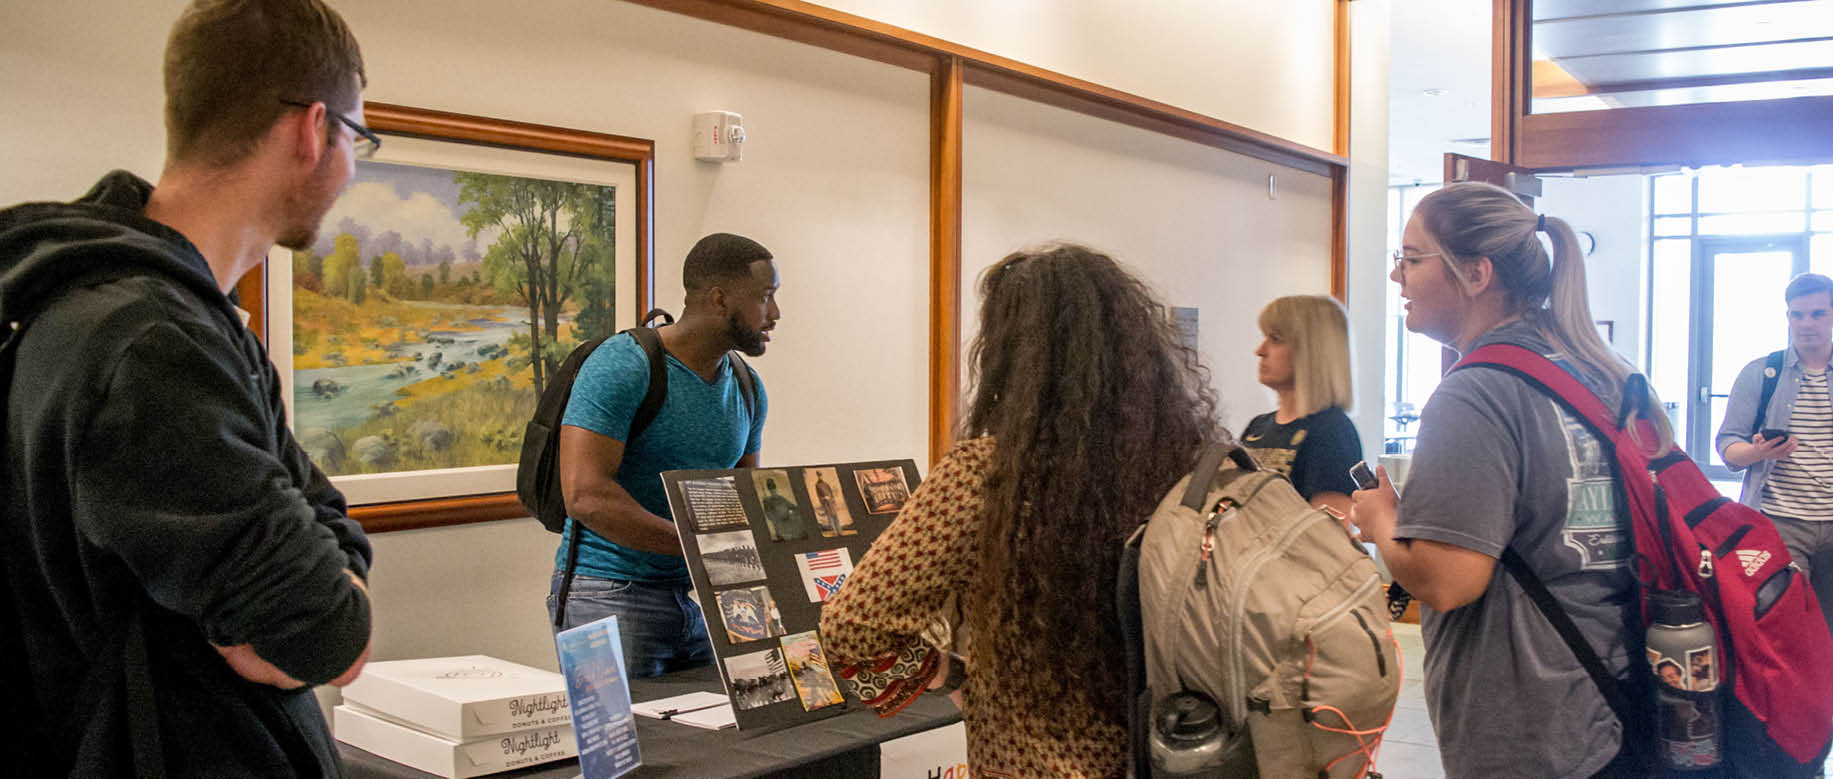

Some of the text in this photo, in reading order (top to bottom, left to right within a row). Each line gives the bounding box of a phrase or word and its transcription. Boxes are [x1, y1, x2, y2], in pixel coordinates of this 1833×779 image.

[1743, 549, 1772, 577] adidas
[509, 695, 569, 718] Nightlight
[512, 719, 539, 729] DONUTS
[501, 730, 561, 756] Nightlight
[505, 758, 533, 768] DONUTS
[540, 750, 565, 760] COFFEE
